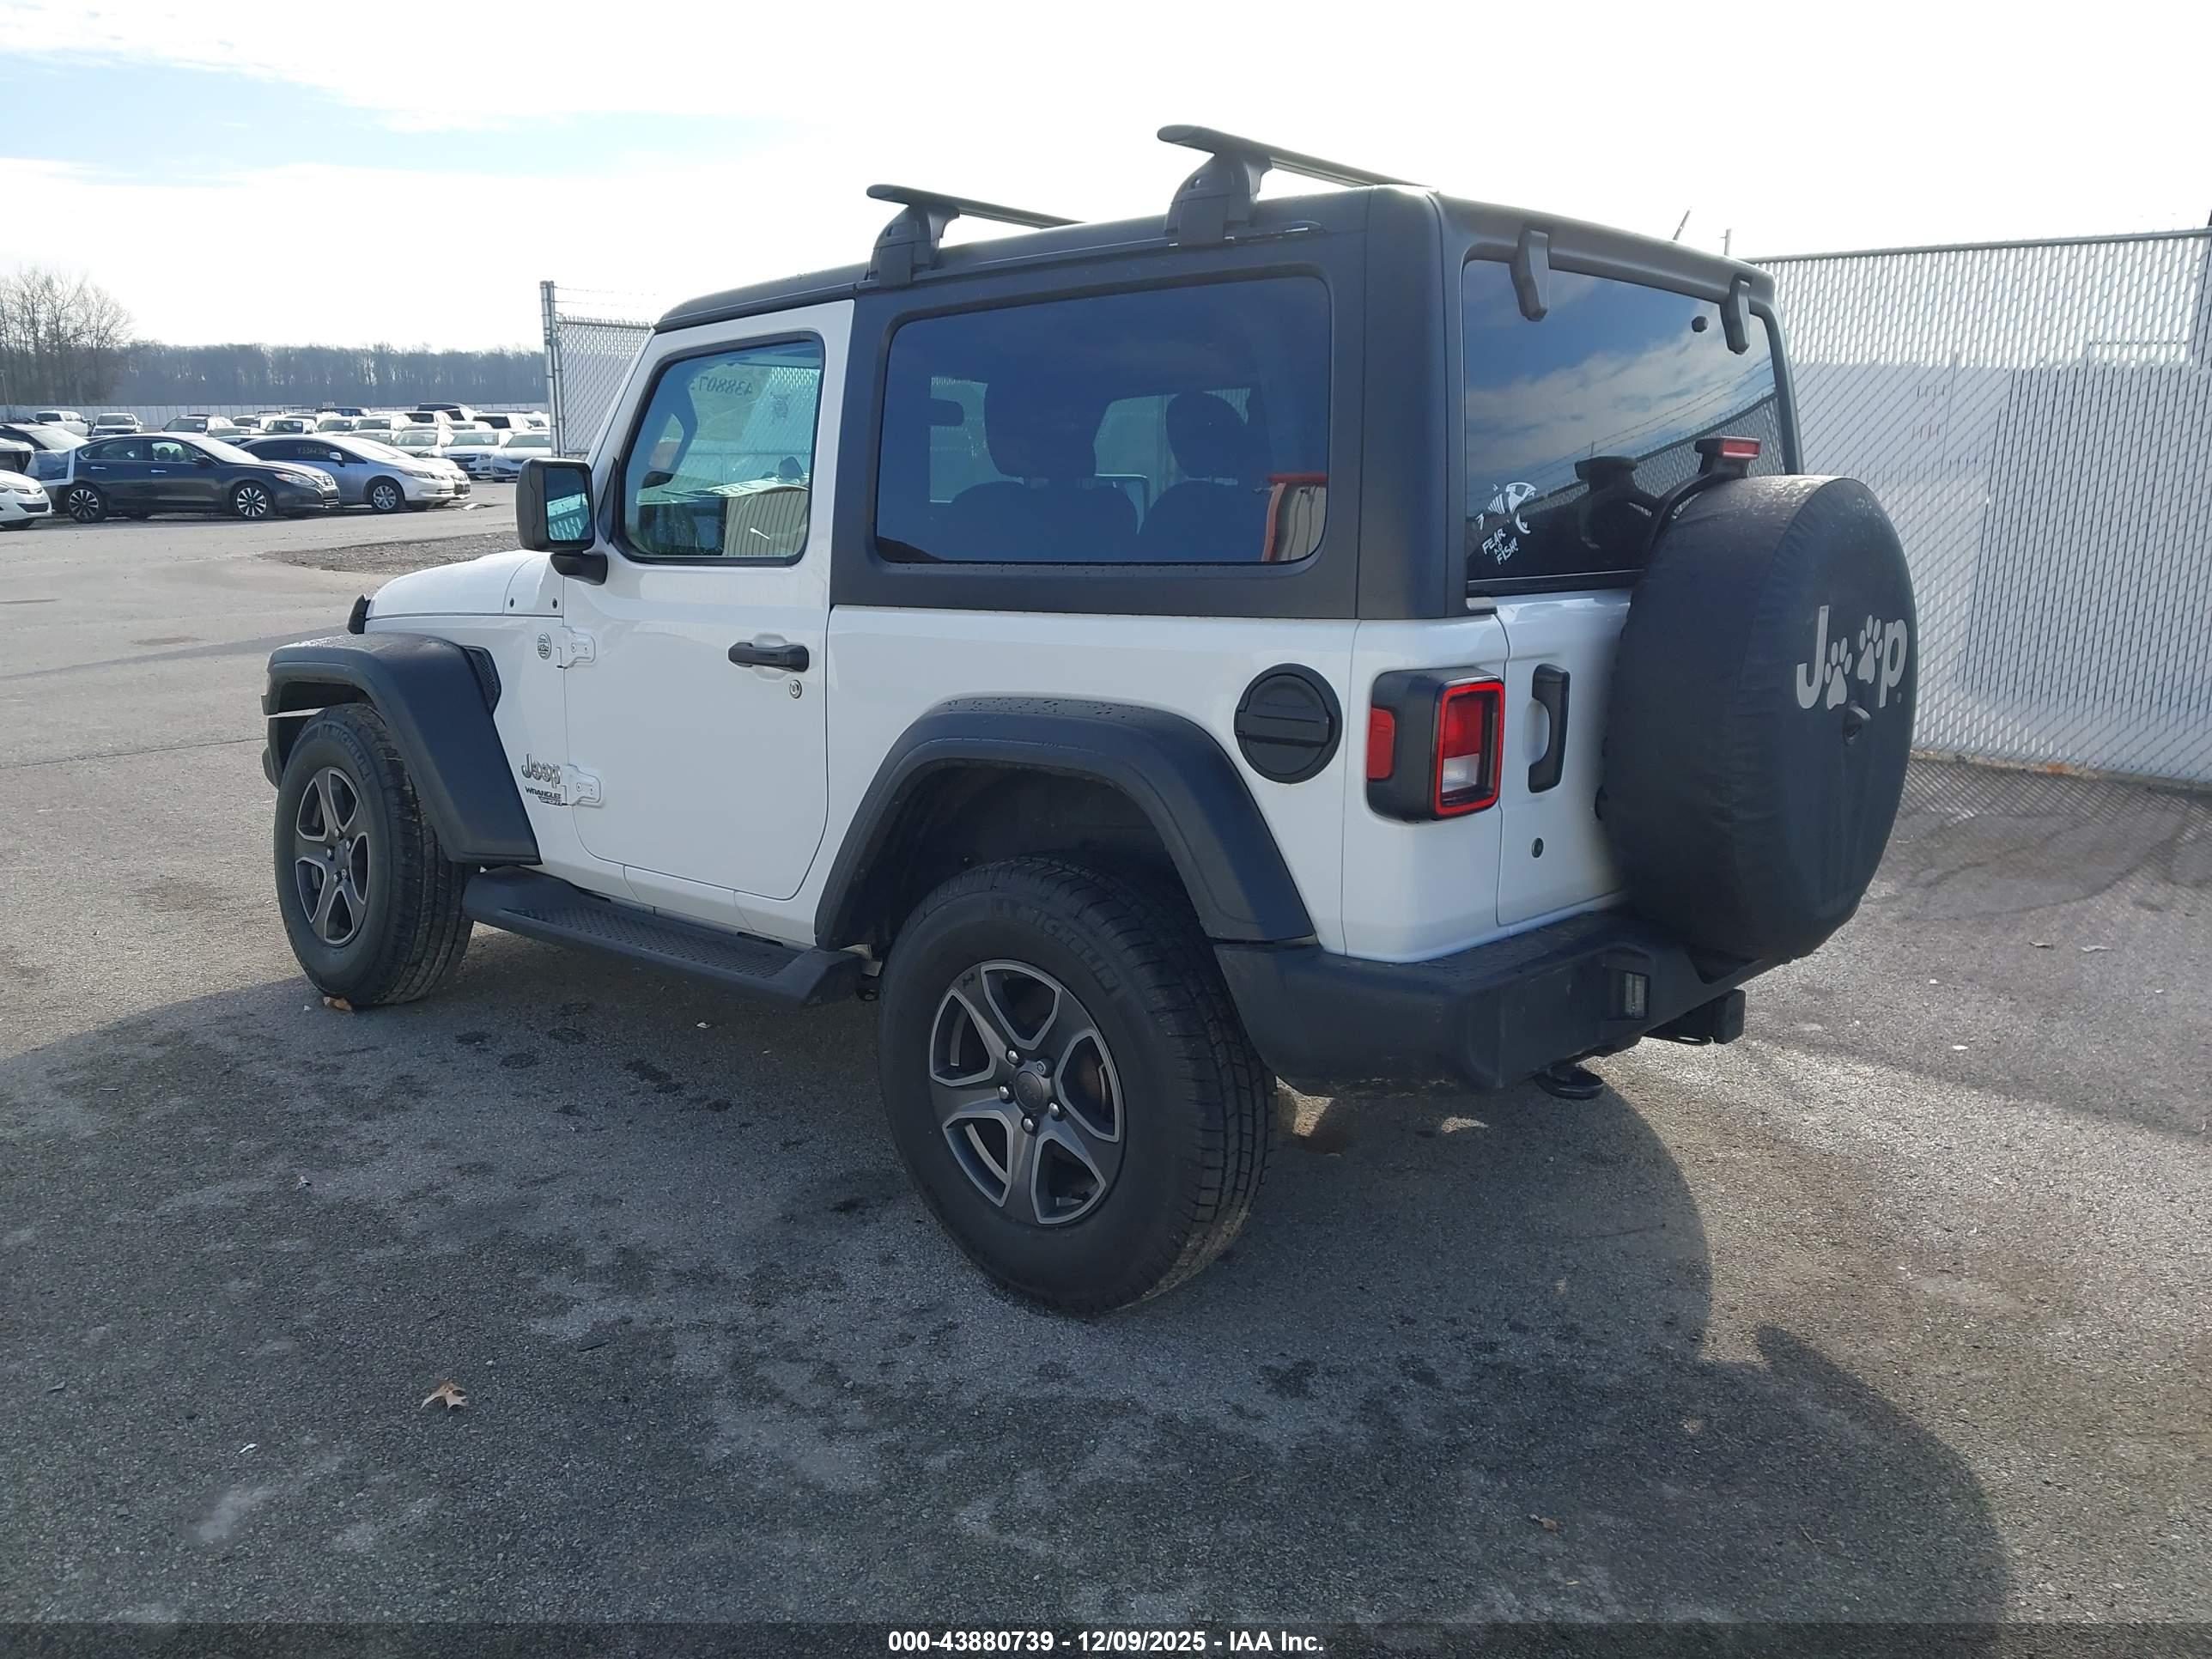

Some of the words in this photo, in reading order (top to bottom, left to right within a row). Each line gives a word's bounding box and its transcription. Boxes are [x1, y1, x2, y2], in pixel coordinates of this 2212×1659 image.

[1482, 527, 1506, 555] FEAR
[1497, 537, 1519, 565] FISH!
[521, 754, 561, 789] Jeep
